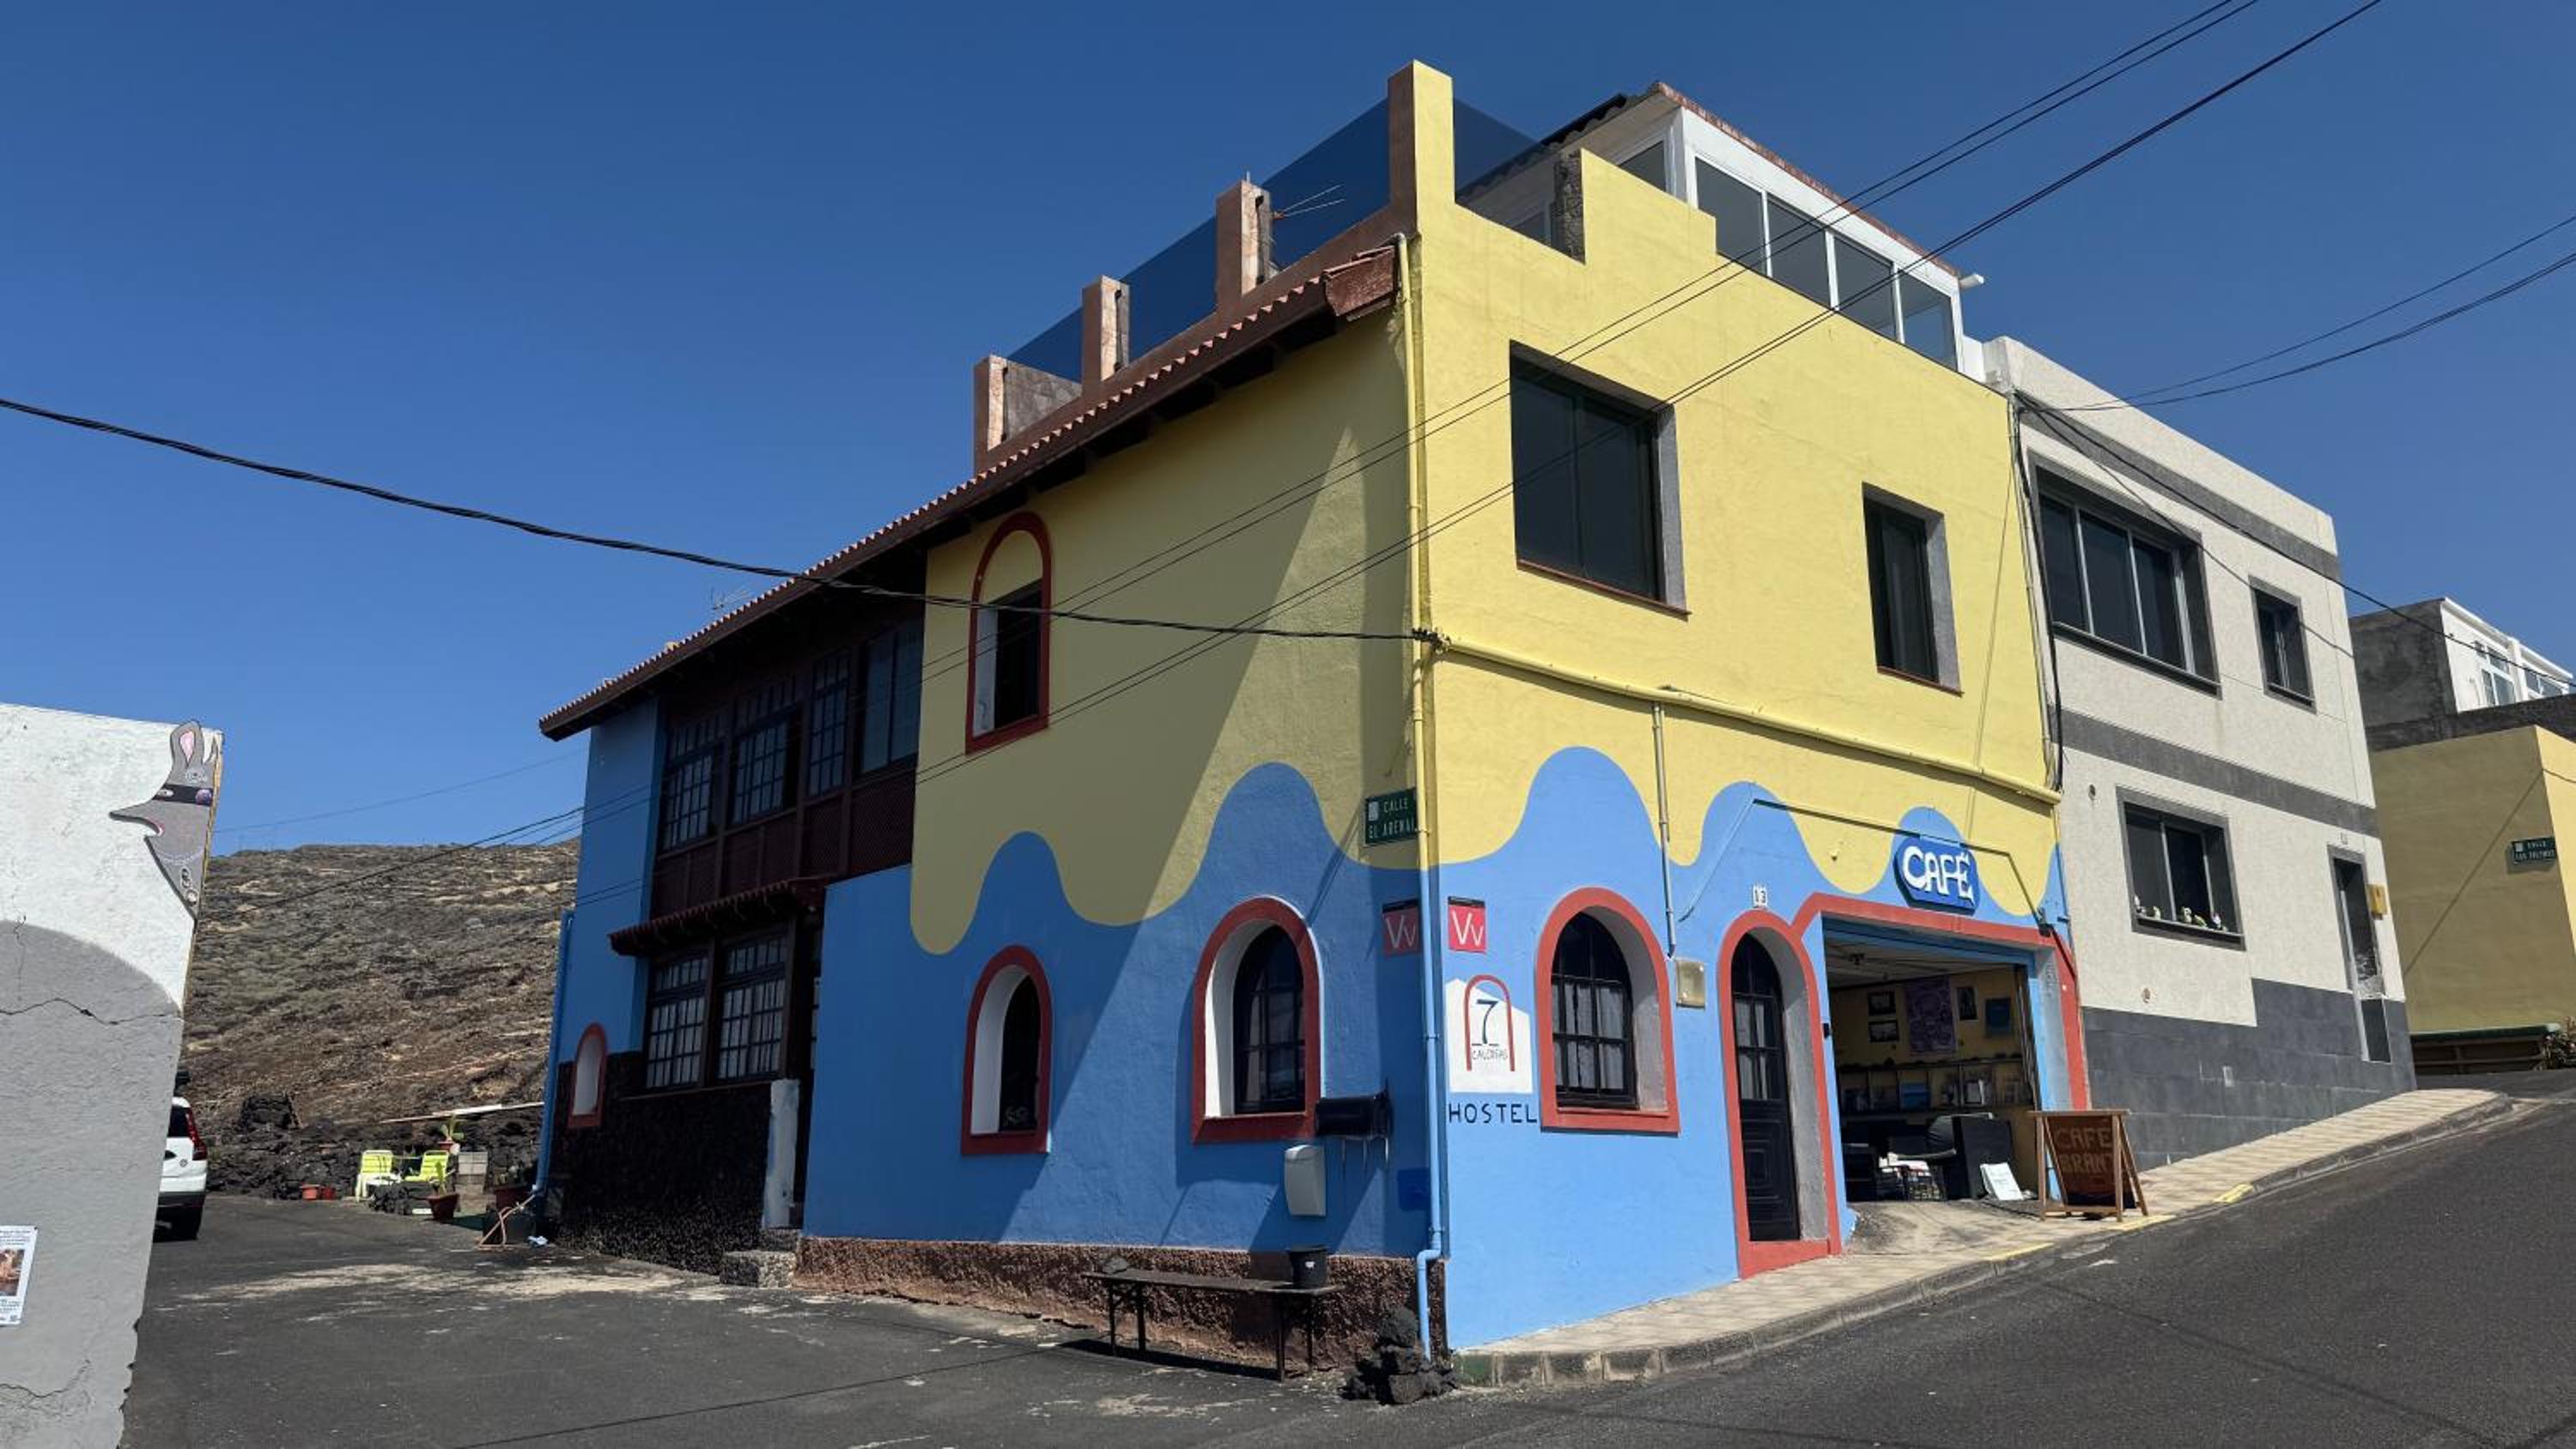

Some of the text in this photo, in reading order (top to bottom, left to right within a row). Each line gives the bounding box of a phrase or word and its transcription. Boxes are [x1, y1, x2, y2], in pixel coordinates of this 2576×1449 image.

[1383, 797, 1408, 814] CALLE
[1369, 824, 1379, 839] EL
[1903, 845, 1975, 905] CAFÉ
[1477, 999, 1499, 1044] 7
[1449, 1103, 1538, 1124] HOSTEL
